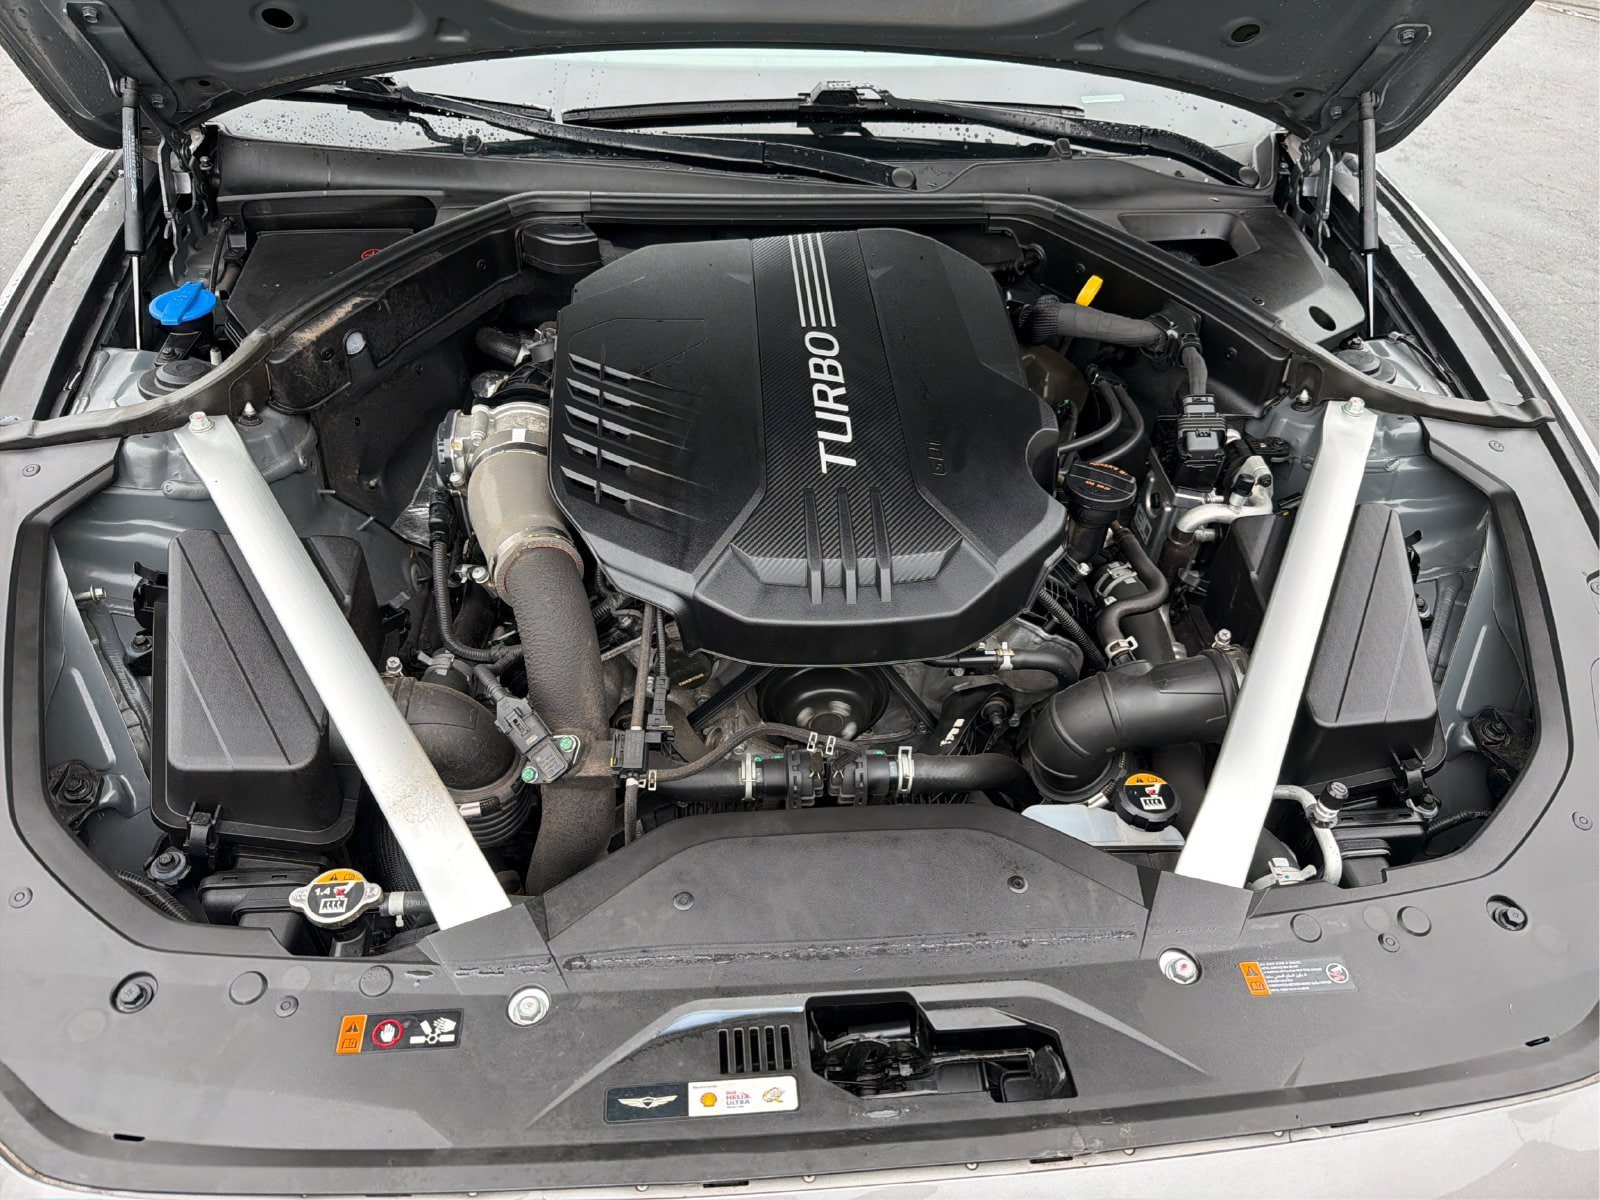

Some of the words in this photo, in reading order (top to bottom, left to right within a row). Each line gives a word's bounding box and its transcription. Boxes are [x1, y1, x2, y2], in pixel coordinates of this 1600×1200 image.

[804, 331, 857, 474] TURBO
[314, 886, 331, 896] 1.4
[366, 886, 378, 896] 1.4
